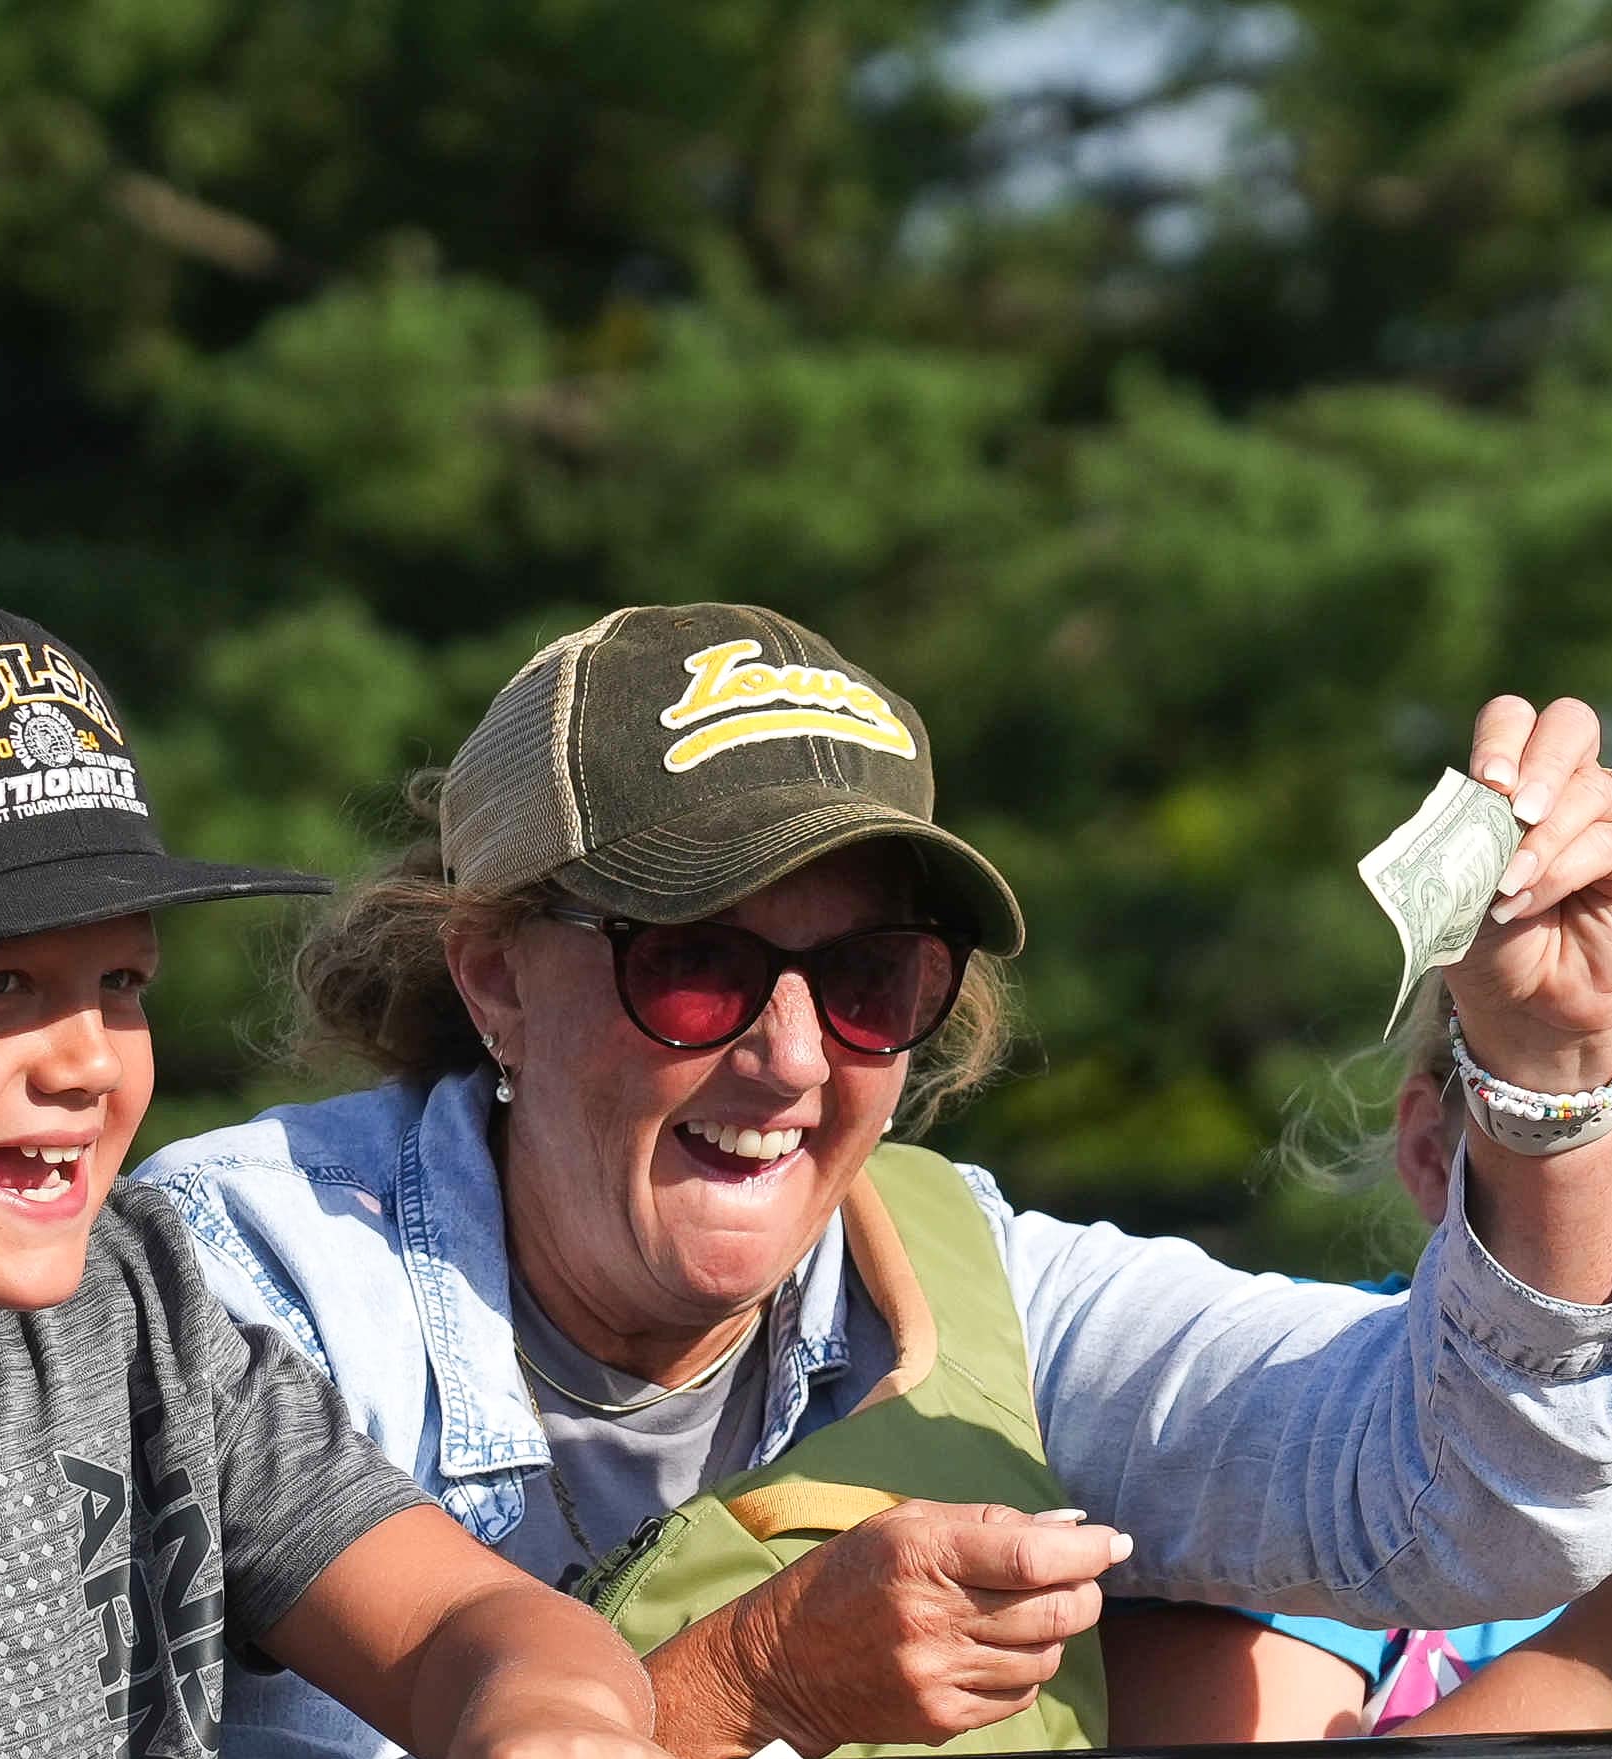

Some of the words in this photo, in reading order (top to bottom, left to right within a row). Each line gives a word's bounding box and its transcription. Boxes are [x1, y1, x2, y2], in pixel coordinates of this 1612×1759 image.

[660, 639, 909, 758] Iowa
[14, 704, 32, 724] OF
[12, 794, 100, 820] TOURNAMENT
